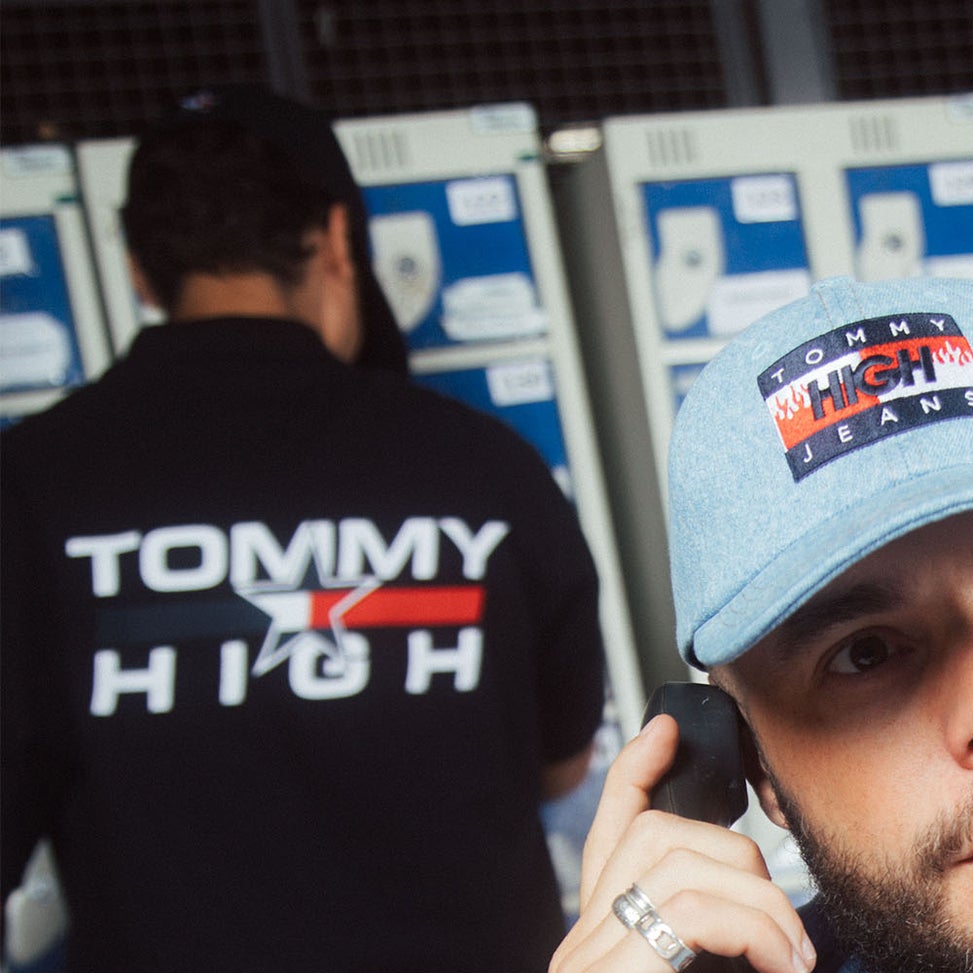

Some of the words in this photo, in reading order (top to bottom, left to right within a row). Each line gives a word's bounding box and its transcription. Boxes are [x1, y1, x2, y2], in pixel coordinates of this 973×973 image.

[772, 318, 945, 384] TOMMY
[807, 346, 937, 421] HIGH
[65, 517, 511, 597] TOMMY
[90, 627, 484, 717] HIGH
